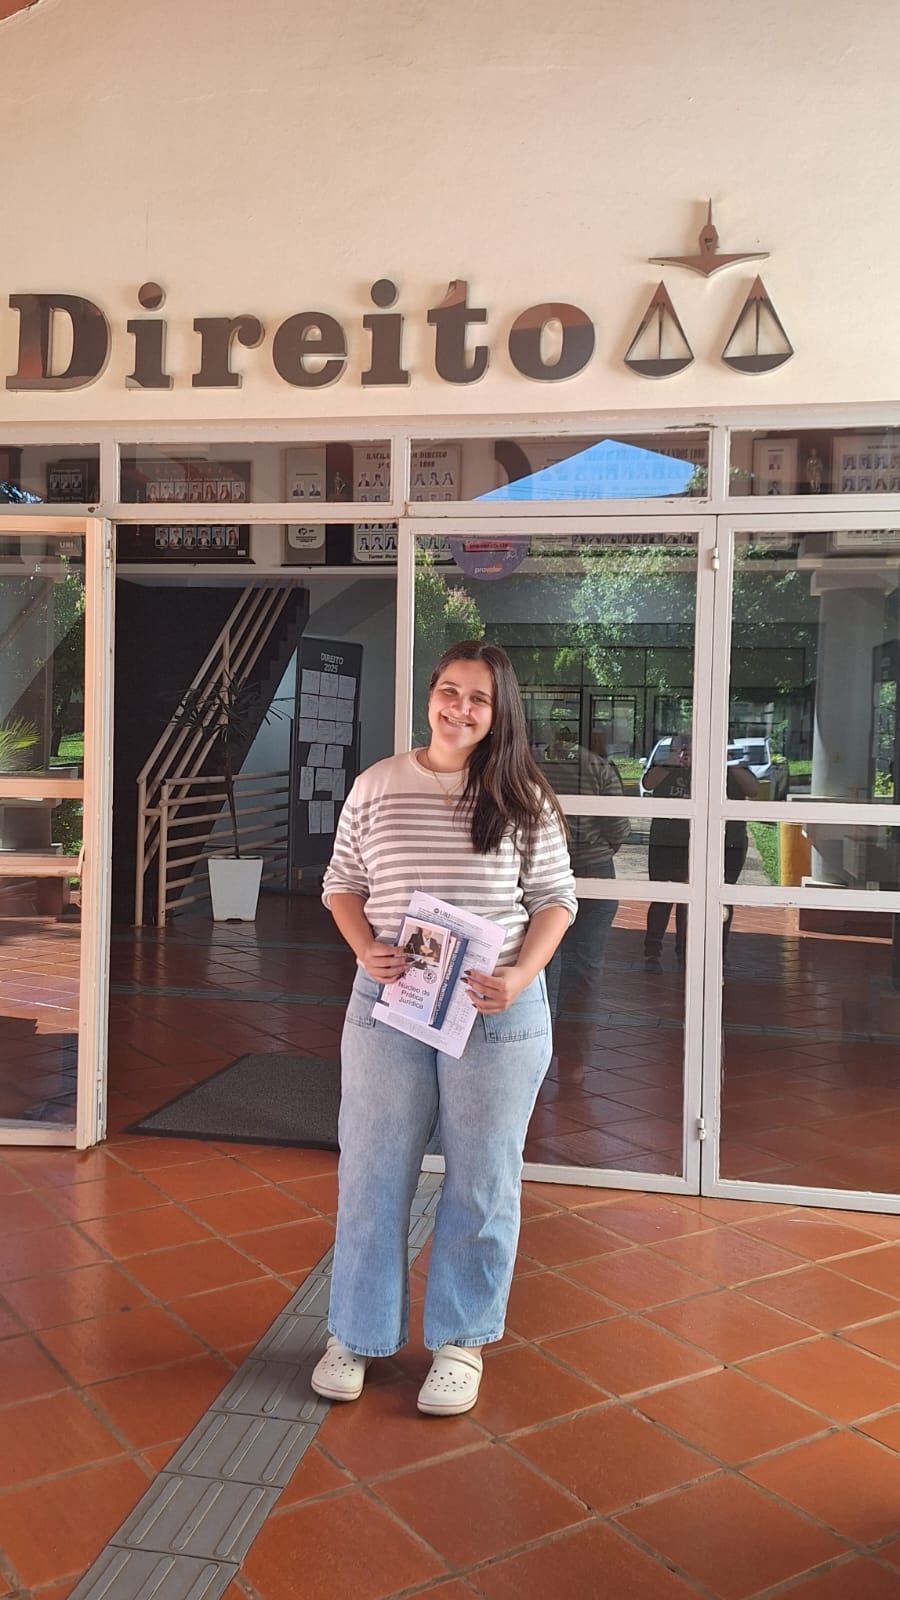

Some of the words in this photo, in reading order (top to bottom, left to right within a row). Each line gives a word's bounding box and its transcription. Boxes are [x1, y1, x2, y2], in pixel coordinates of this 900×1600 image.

[5, 279, 597, 391] Direito
[321, 652, 344, 665] DIREITO
[323, 663, 339, 673] 2025
[398, 981, 421, 994] Núcleo
[400, 989, 424, 1002] Prática
[398, 997, 424, 1010] Jurídica
